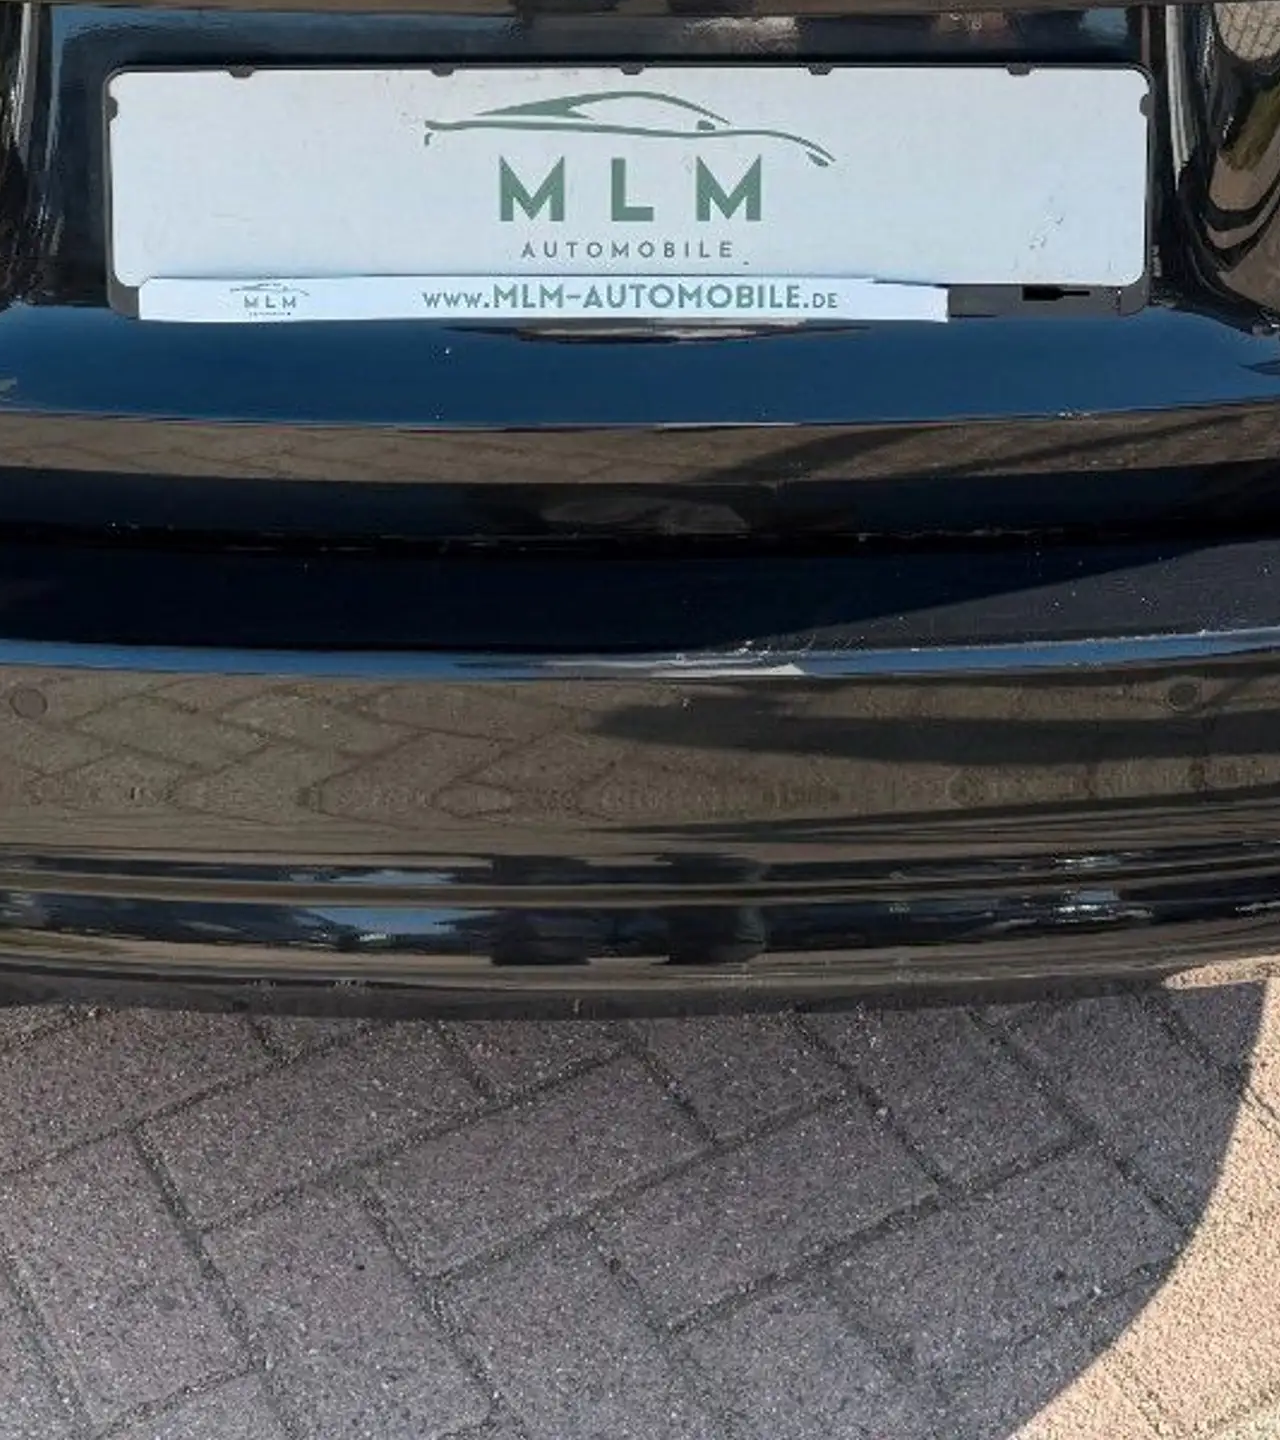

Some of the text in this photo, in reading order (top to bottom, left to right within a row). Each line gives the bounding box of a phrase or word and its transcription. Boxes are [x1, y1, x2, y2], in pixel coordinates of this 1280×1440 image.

[499, 155, 762, 222] MLM
[521, 241, 734, 259] AUTOMOBILE
[243, 294, 297, 309] MLM
